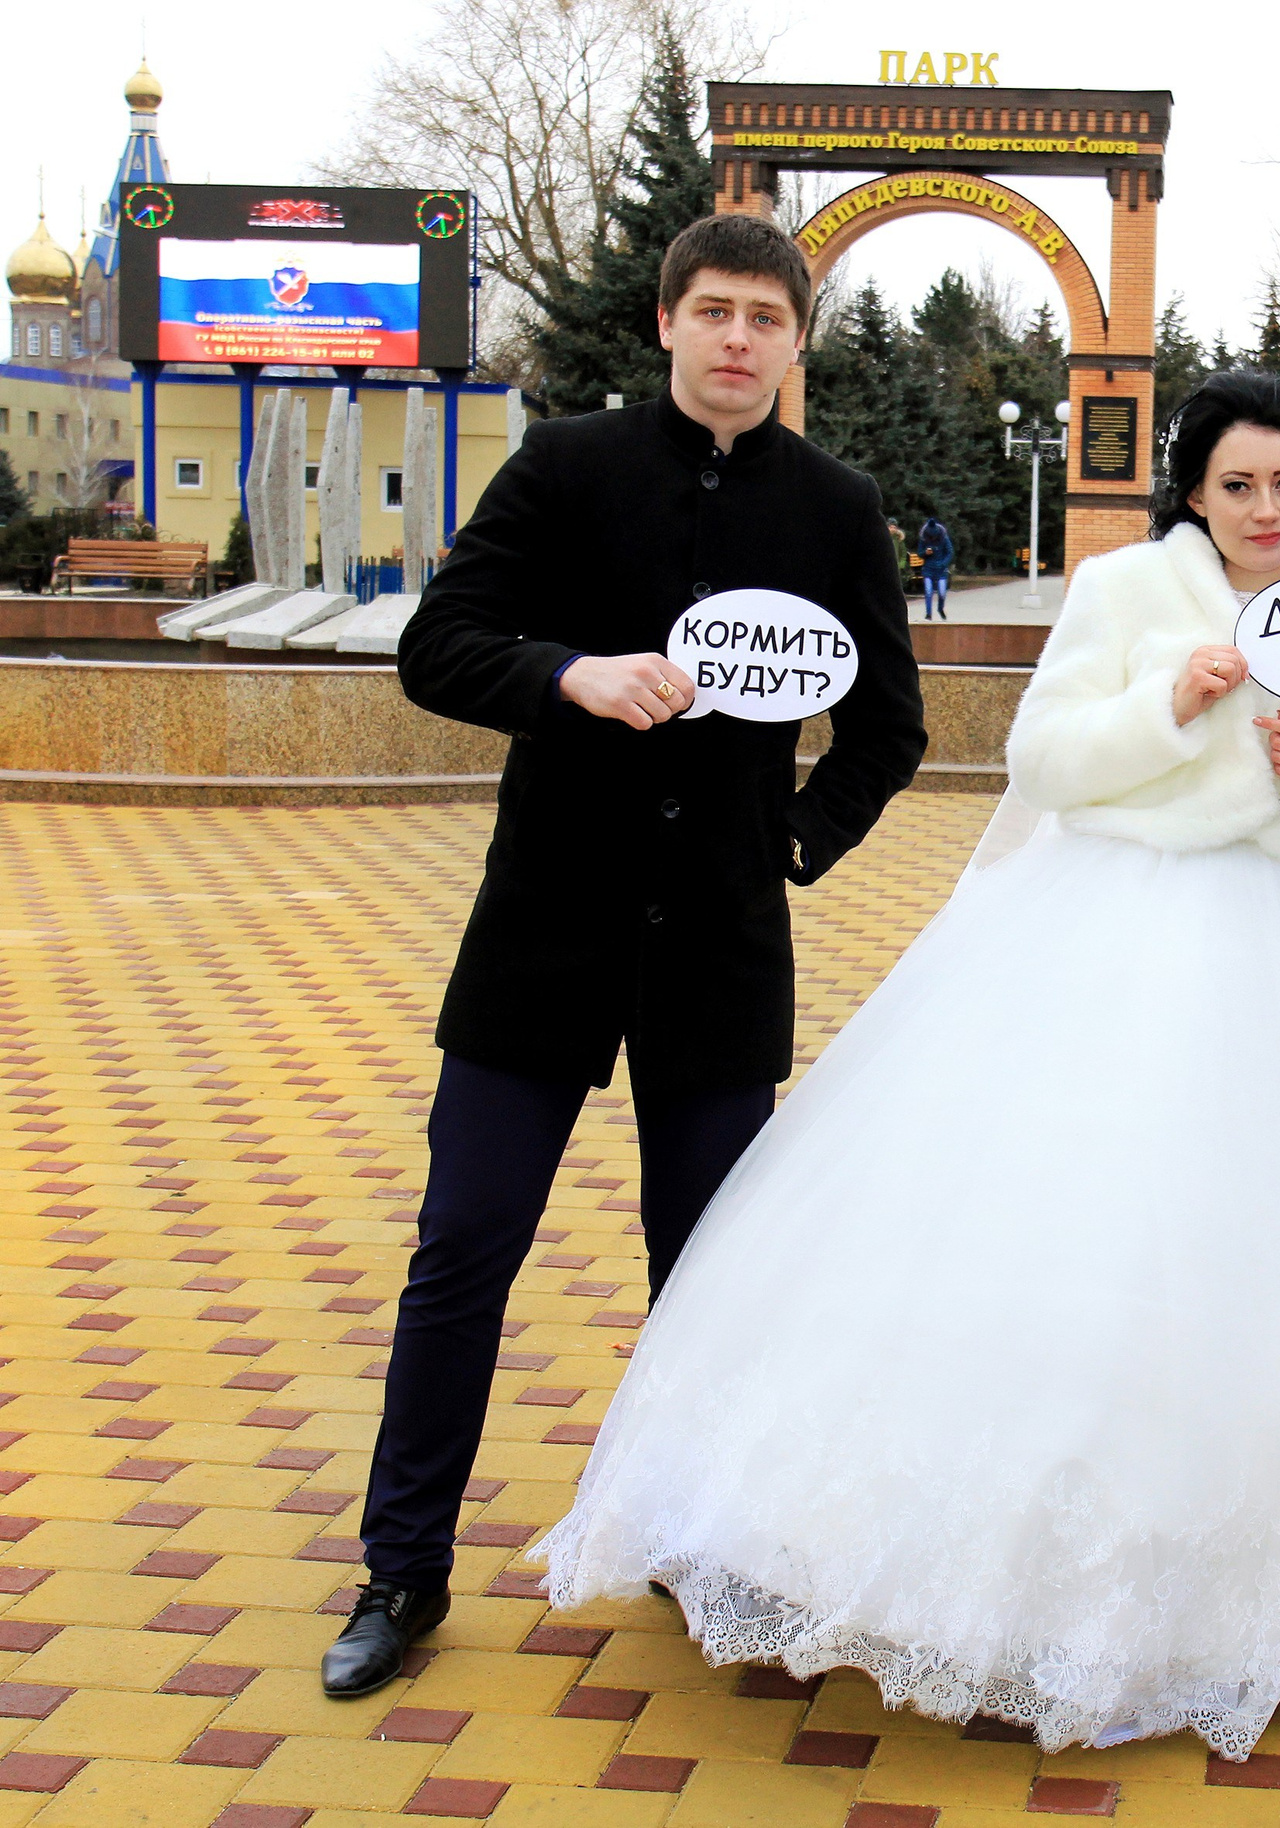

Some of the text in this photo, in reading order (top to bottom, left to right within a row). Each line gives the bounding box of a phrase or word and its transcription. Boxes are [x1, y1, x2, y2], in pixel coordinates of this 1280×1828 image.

[879, 50, 999, 85] ПАРК
[733, 131, 1139, 154] имени первого Героя Советского Союза
[800, 177, 1066, 265] Ляпидевского А.В.
[346, 316, 383, 327] часть
[683, 617, 851, 658] КОРМИТЬ
[697, 661, 831, 699] БУДУТ?
